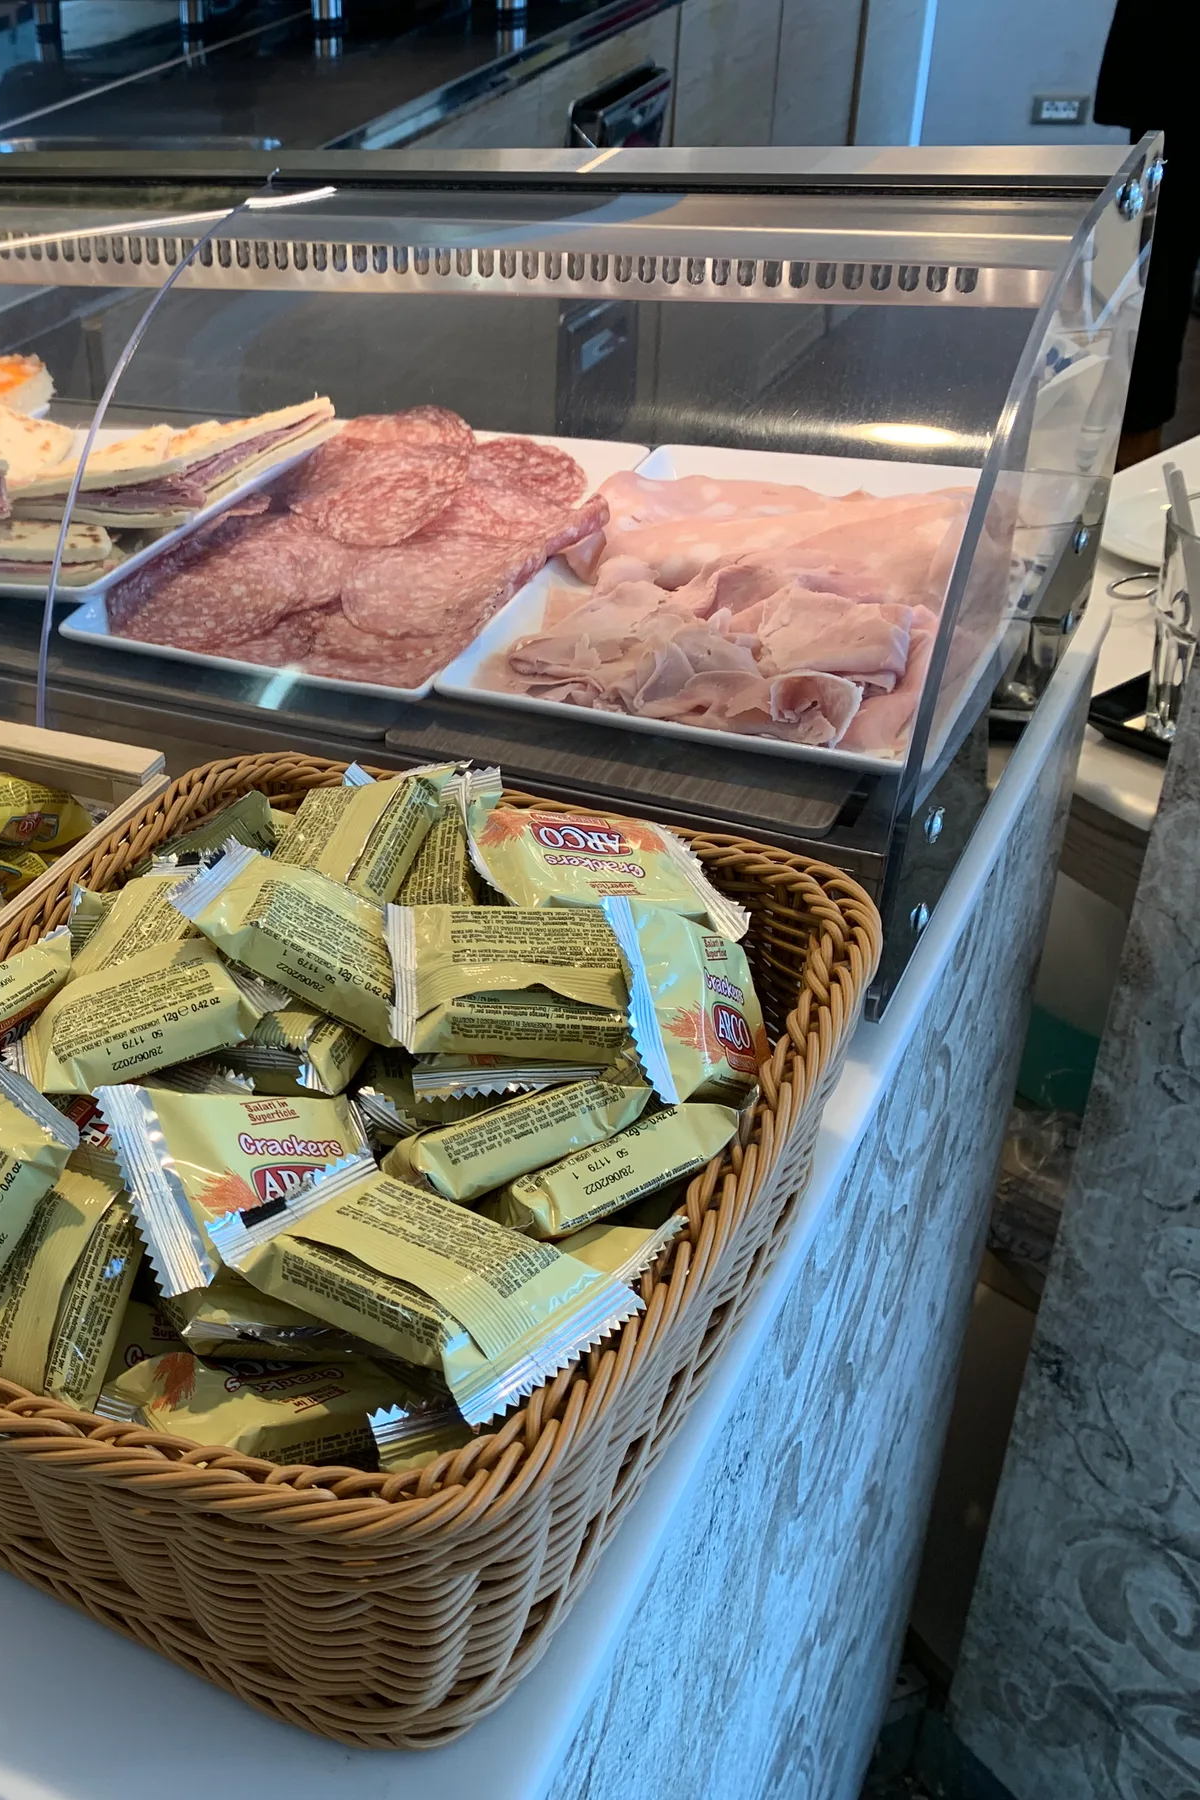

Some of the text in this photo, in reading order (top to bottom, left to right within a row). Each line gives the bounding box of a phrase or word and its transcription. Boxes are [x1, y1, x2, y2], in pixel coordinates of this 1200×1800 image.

[539, 826, 621, 854] ARCO
[546, 854, 645, 879] Crackers
[275, 960, 325, 992] 28/06/2022
[296, 957, 319, 974] 1179
[323, 973, 336, 984] 50
[336, 966, 353, 982] 12g
[363, 981, 382, 995] 0.42
[704, 967, 744, 1005] Crackers
[111, 1030, 128, 1041] WEIGHT
[162, 1011, 179, 1024] 12g
[190, 1000, 209, 1012] 0.42
[209, 996, 220, 1005] oz
[718, 1009, 749, 1050] ARCO
[121, 1035, 144, 1049] 1179
[151, 1029, 163, 1039] 50
[110, 1045, 164, 1070] 28/06/2022
[244, 1100, 289, 1114] Salati in
[248, 1107, 297, 1123] Superficie
[238, 1132, 344, 1158] Crackers
[616, 1147, 629, 1158] 50
[11, 1161, 22, 1174] oz
[587, 1155, 611, 1173] 1179
[583, 1164, 634, 1196] 28/06/2022
